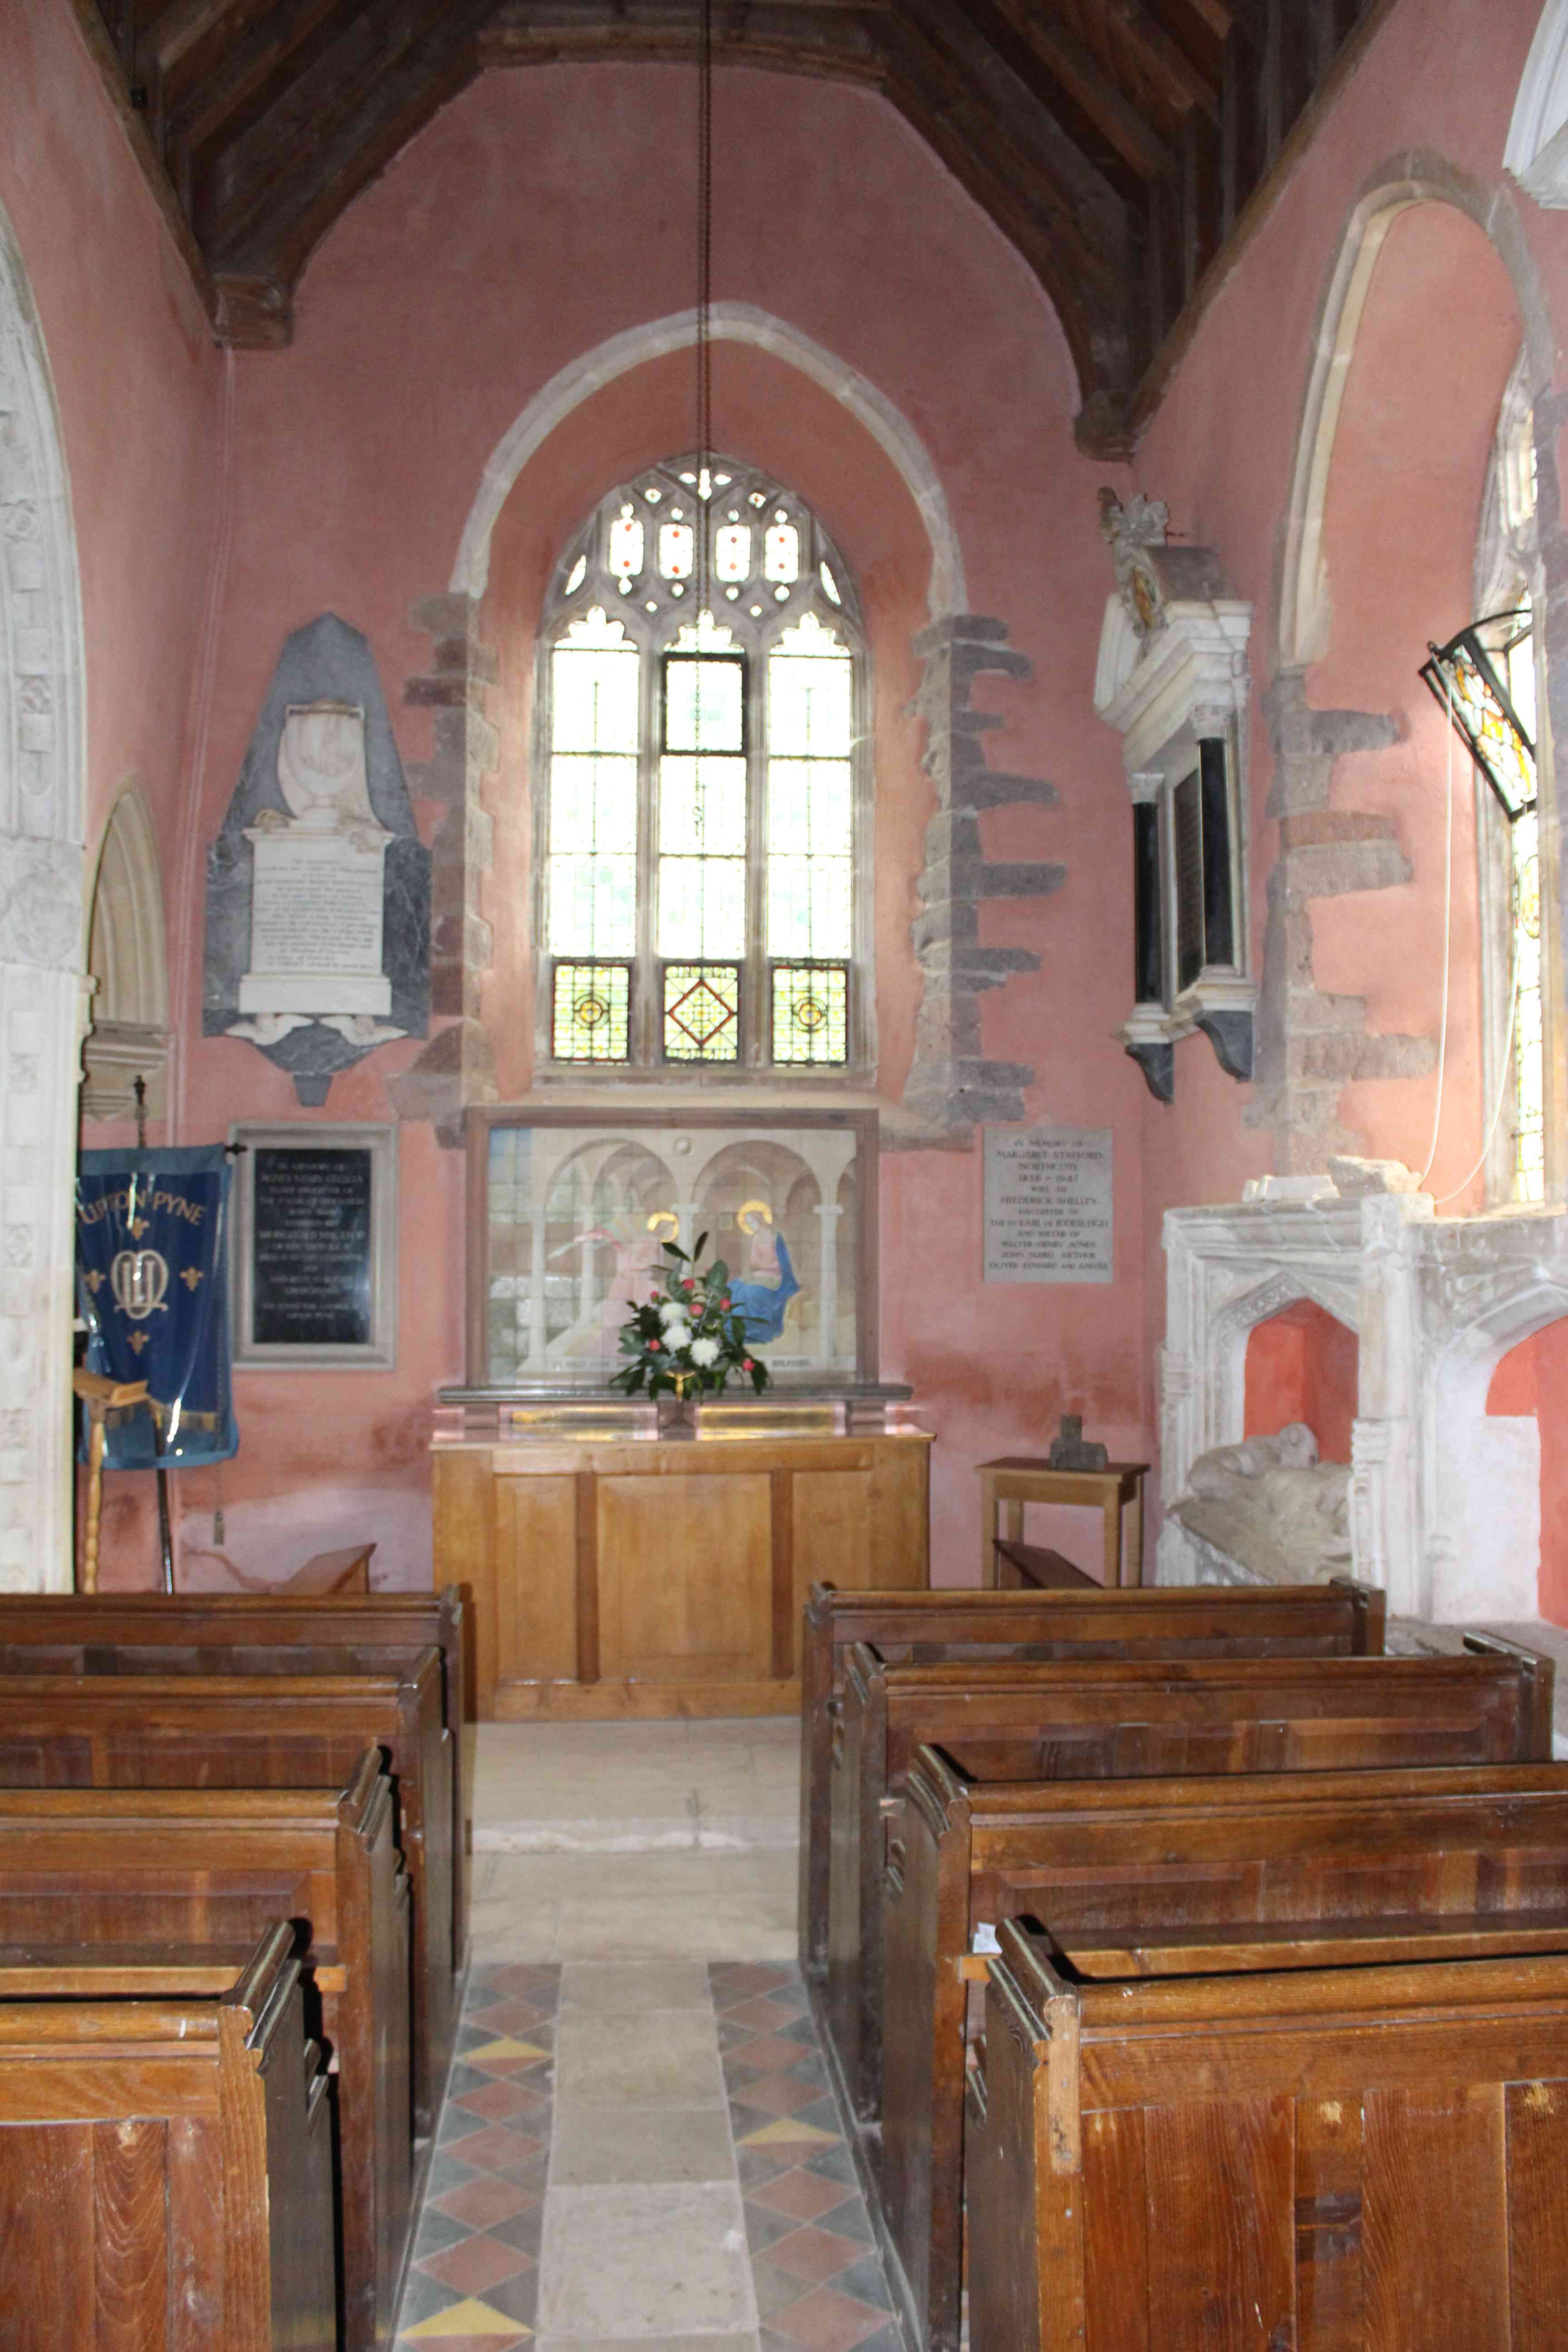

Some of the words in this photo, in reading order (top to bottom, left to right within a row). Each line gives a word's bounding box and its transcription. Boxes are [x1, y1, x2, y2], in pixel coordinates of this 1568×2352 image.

[1018, 1163, 1077, 1171] NORTHCOTE
[1056, 1174, 1078, 1182] 1947
[1001, 1196, 1052, 1205] FREDERICK
[1056, 1196, 1097, 1205] SHELLEY
[153, 1191, 207, 1226] PYNE
